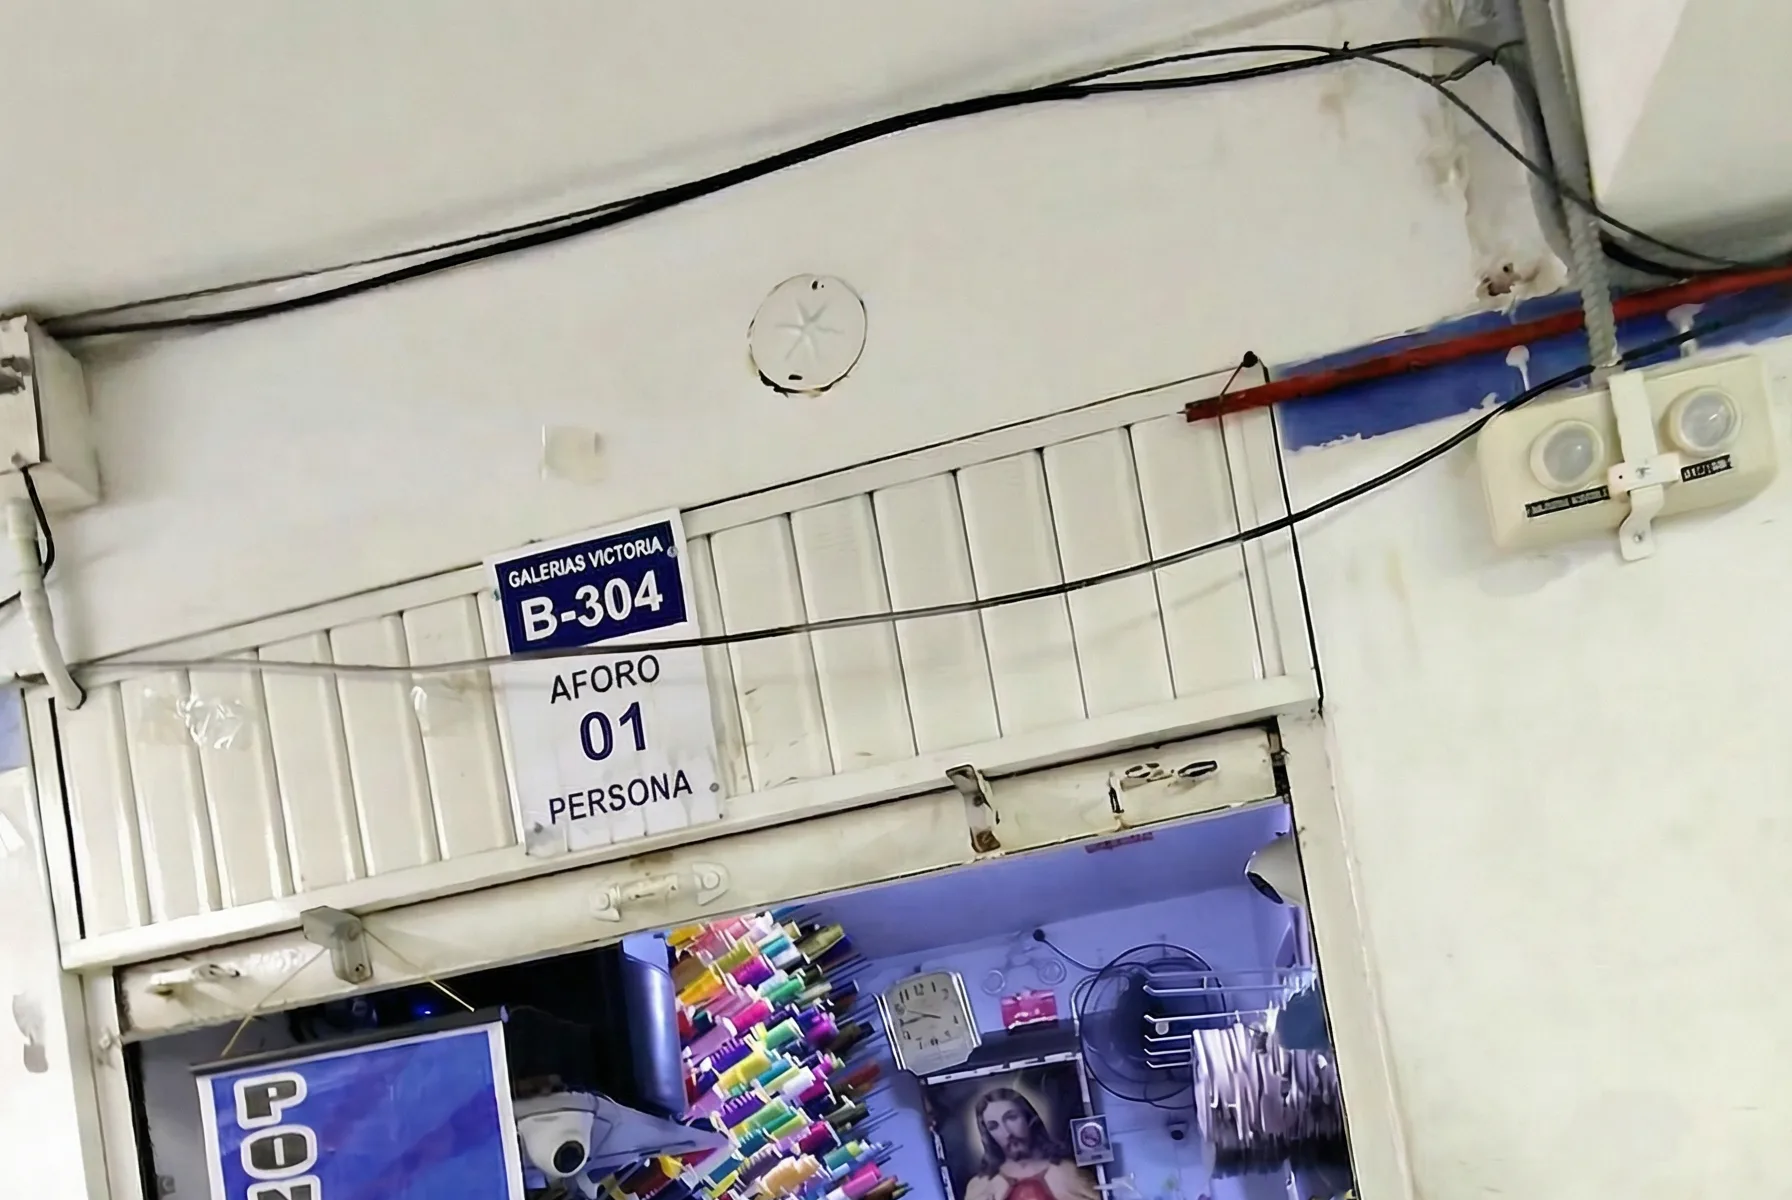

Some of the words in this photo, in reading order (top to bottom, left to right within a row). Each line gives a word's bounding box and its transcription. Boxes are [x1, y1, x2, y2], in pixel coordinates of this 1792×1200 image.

[508, 553, 586, 588] GALERIAS
[588, 535, 664, 566] VICTORIA
[520, 570, 664, 642] B-304
[550, 654, 661, 704] AFORO
[579, 701, 647, 761] 01
[548, 769, 694, 825] PERSONA
